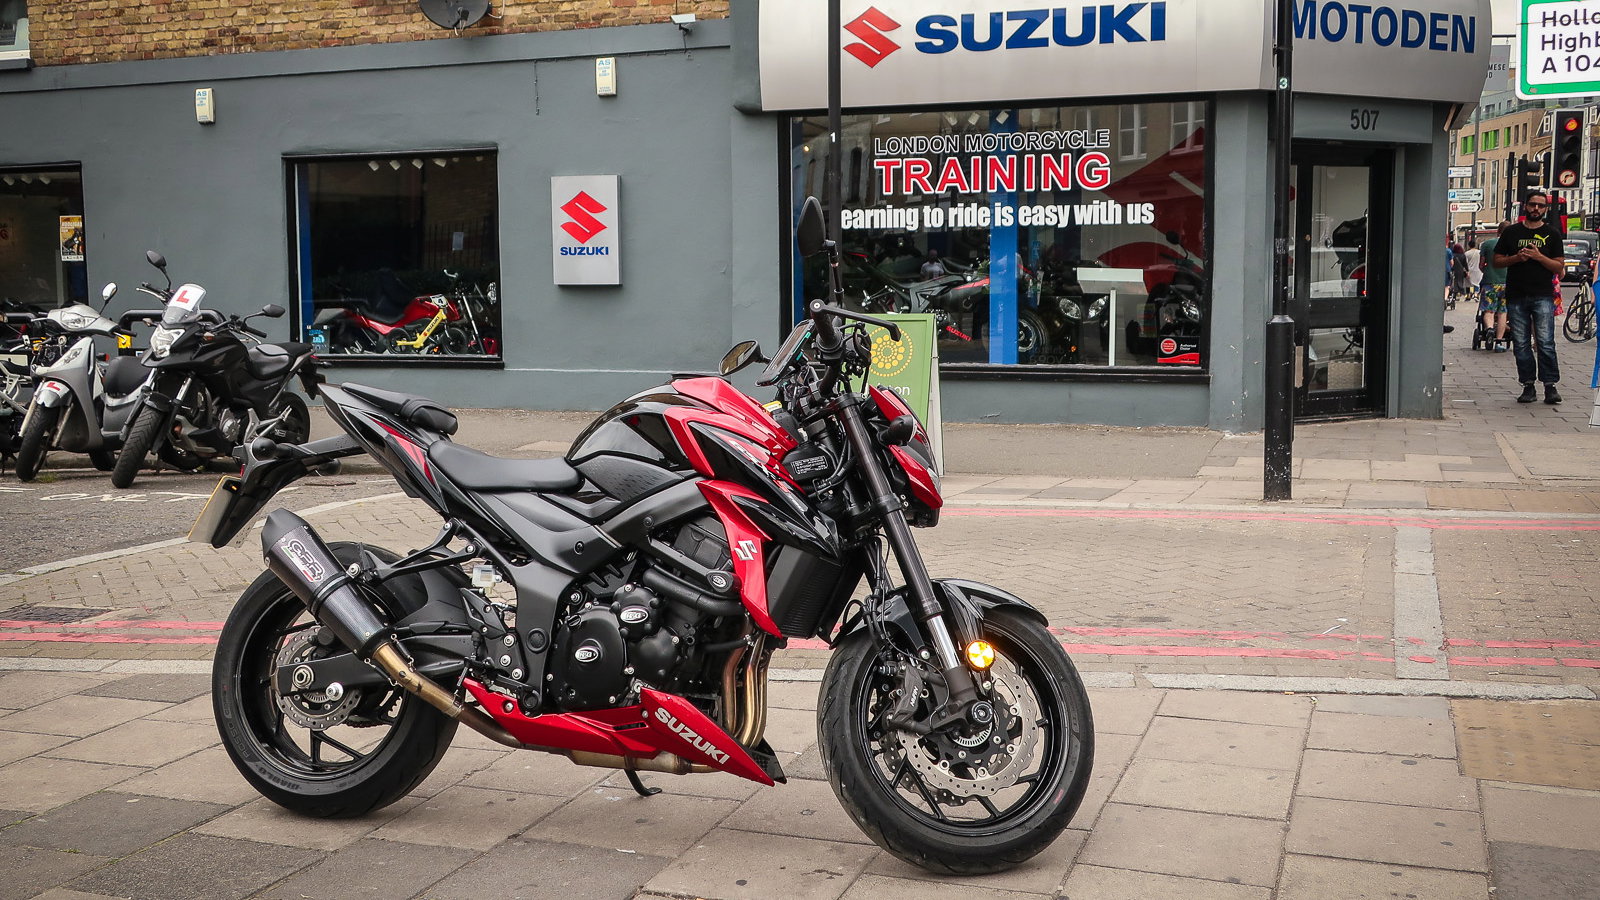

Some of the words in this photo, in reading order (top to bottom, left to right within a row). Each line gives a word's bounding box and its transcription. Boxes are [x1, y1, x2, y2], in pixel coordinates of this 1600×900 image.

[915, 1, 1166, 54] SUZUKI
[1292, 0, 1476, 53] MOTODEN
[1541, 57, 1557, 73] A
[1279, 77, 1288, 89] 3
[1350, 109, 1380, 131] 507
[830, 131, 836, 143] 1
[874, 135, 958, 155] LONDON
[964, 129, 1111, 152] MOTORCYCLE
[874, 151, 1111, 195] TRAINING
[841, 204, 919, 231] earning
[923, 205, 944, 228] to
[948, 202, 991, 228] ride
[994, 202, 1014, 227] is
[1018, 205, 1071, 229] easy
[1074, 200, 1122, 226] with
[1126, 202, 1155, 225] us
[560, 246, 609, 256] SUZUKI
[176, 290, 190, 304] L
[945, 325, 973, 342] SUZUKI
[655, 707, 731, 765] SUZUKI
